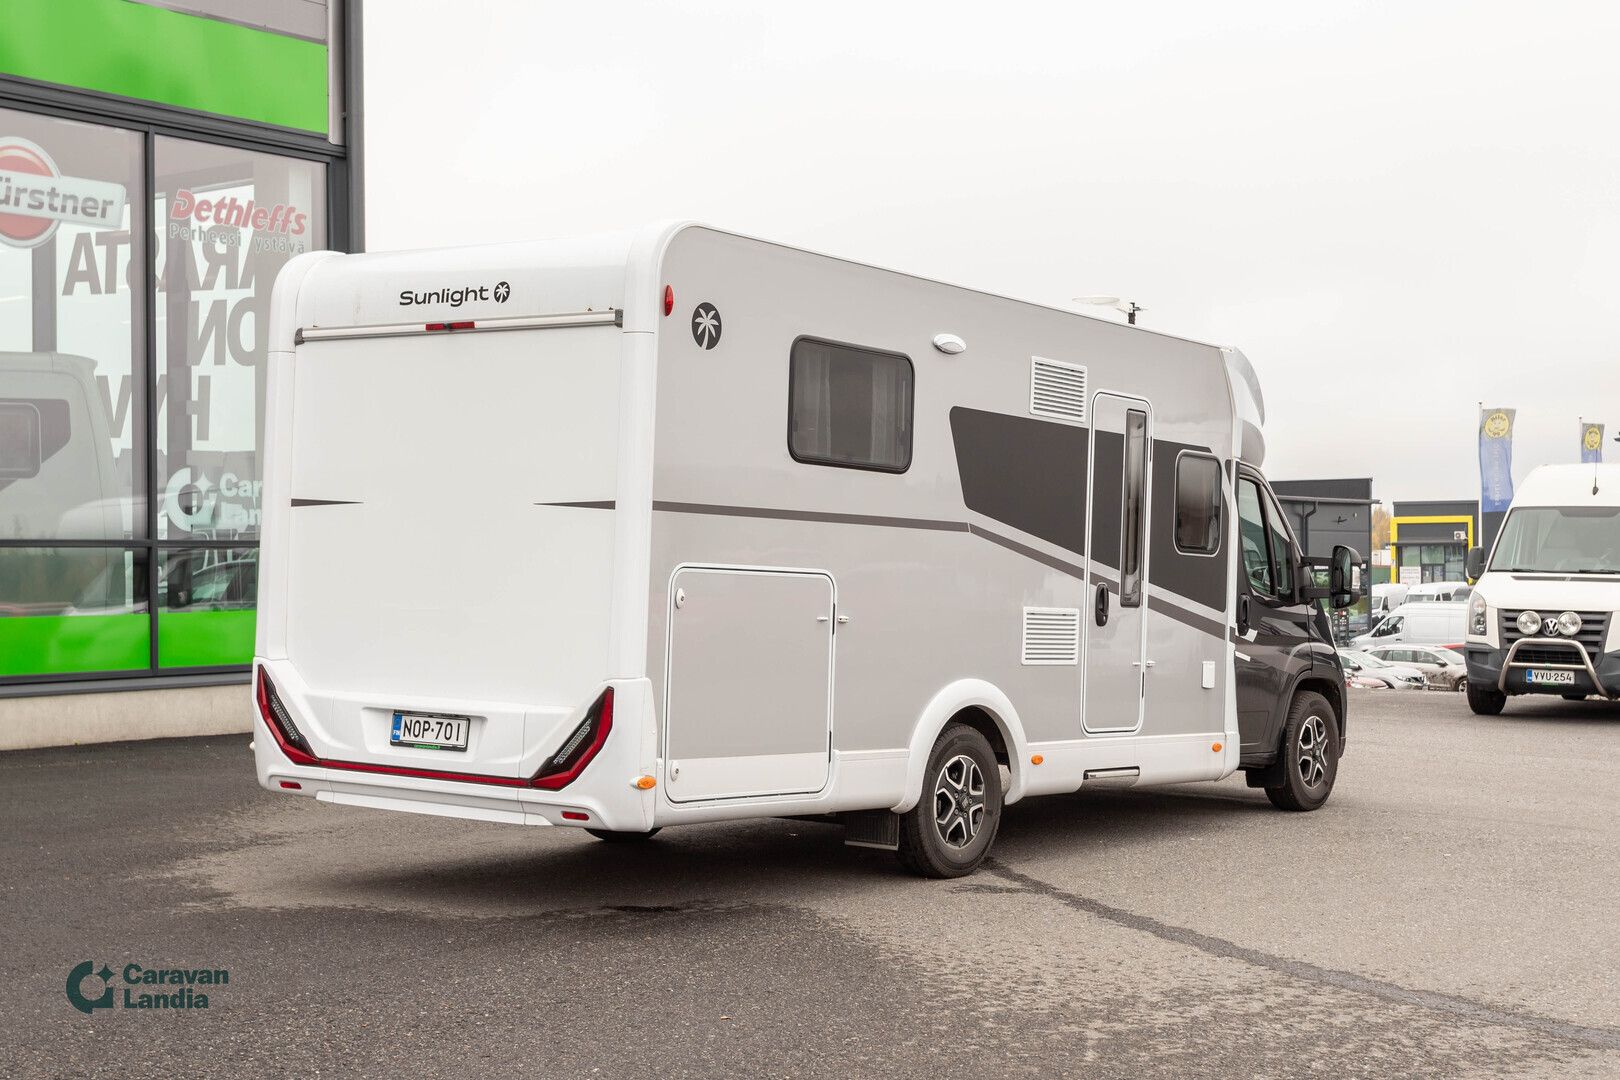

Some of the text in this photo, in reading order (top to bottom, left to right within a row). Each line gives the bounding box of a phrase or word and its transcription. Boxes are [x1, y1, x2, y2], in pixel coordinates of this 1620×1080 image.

[170, 188, 308, 236] Dethleffs
[169, 222, 305, 255] Perheesi ystävä
[399, 286, 489, 308] Sunlight
[403, 719, 461, 742] NOP-701
